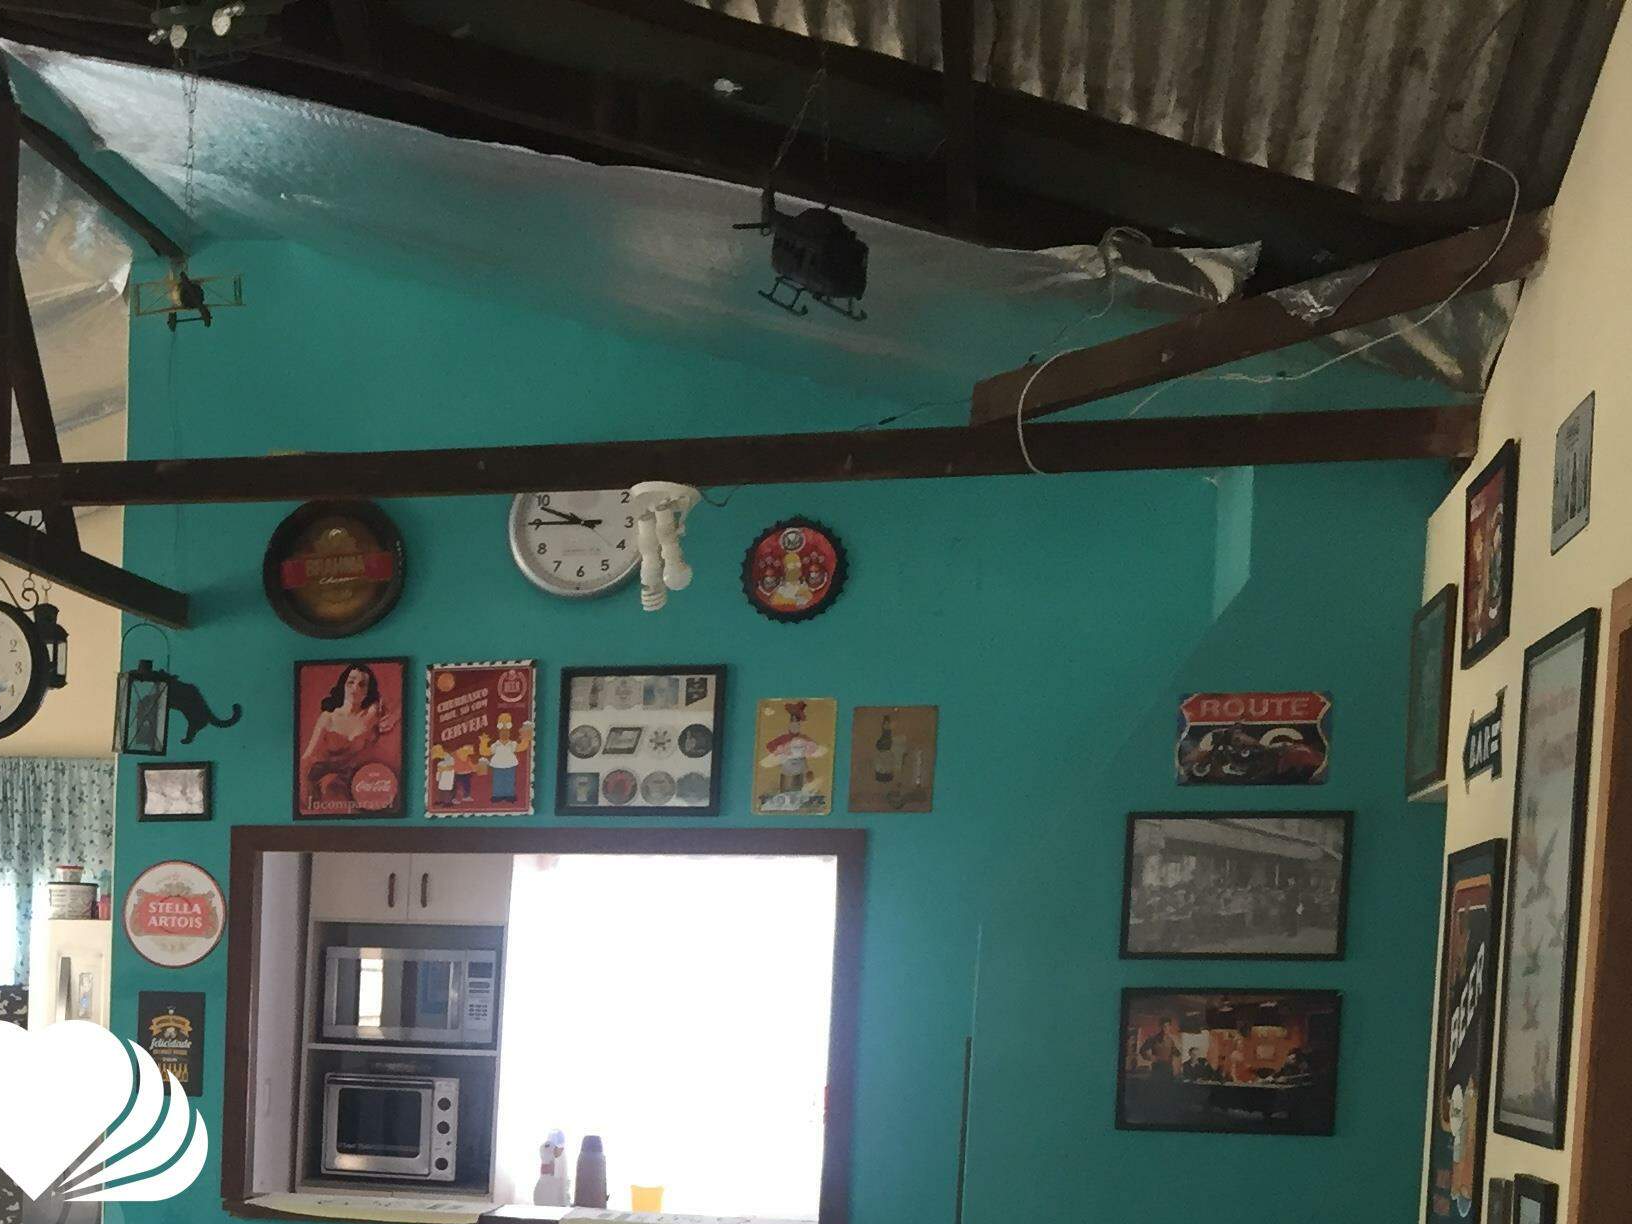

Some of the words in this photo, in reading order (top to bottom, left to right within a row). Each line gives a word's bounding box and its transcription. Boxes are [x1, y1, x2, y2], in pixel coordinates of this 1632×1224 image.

[536, 494, 551, 507] 10
[620, 491, 630, 504] 2
[624, 516, 634, 528] 3
[537, 542, 547, 555] 8
[616, 539, 626, 551] 4
[552, 560, 562, 573] 7
[576, 565, 585, 578] 6
[600, 559, 610, 572] 5
[9, 640, 18, 653] 2
[15, 662, 23, 674] 3
[9, 684, 15, 697] 4
[1199, 697, 1310, 718] ROUTE
[148, 902, 202, 914] STELLA
[148, 915, 203, 929] ARTOIS
[1448, 941, 1485, 1070] BEER
